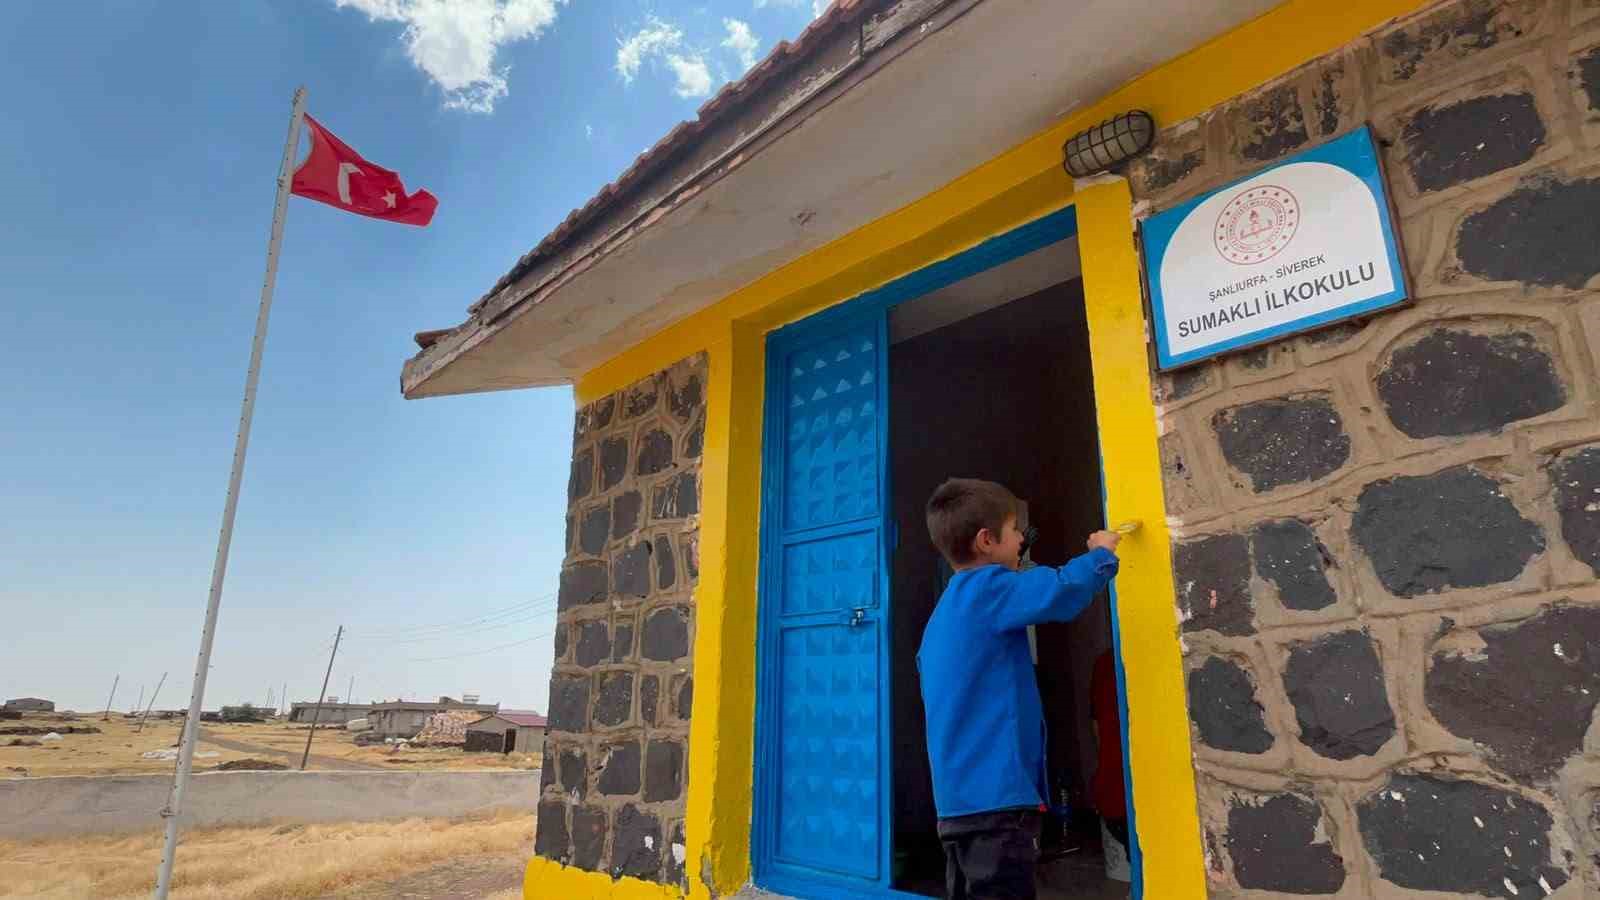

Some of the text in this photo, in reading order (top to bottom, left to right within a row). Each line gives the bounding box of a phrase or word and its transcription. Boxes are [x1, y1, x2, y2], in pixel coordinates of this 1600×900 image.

[1178, 262, 1376, 338] SUMAKLI İLKOKULU
[1209, 274, 1268, 303] ŞANLIURFA
[1275, 254, 1326, 279] SİVEREK
